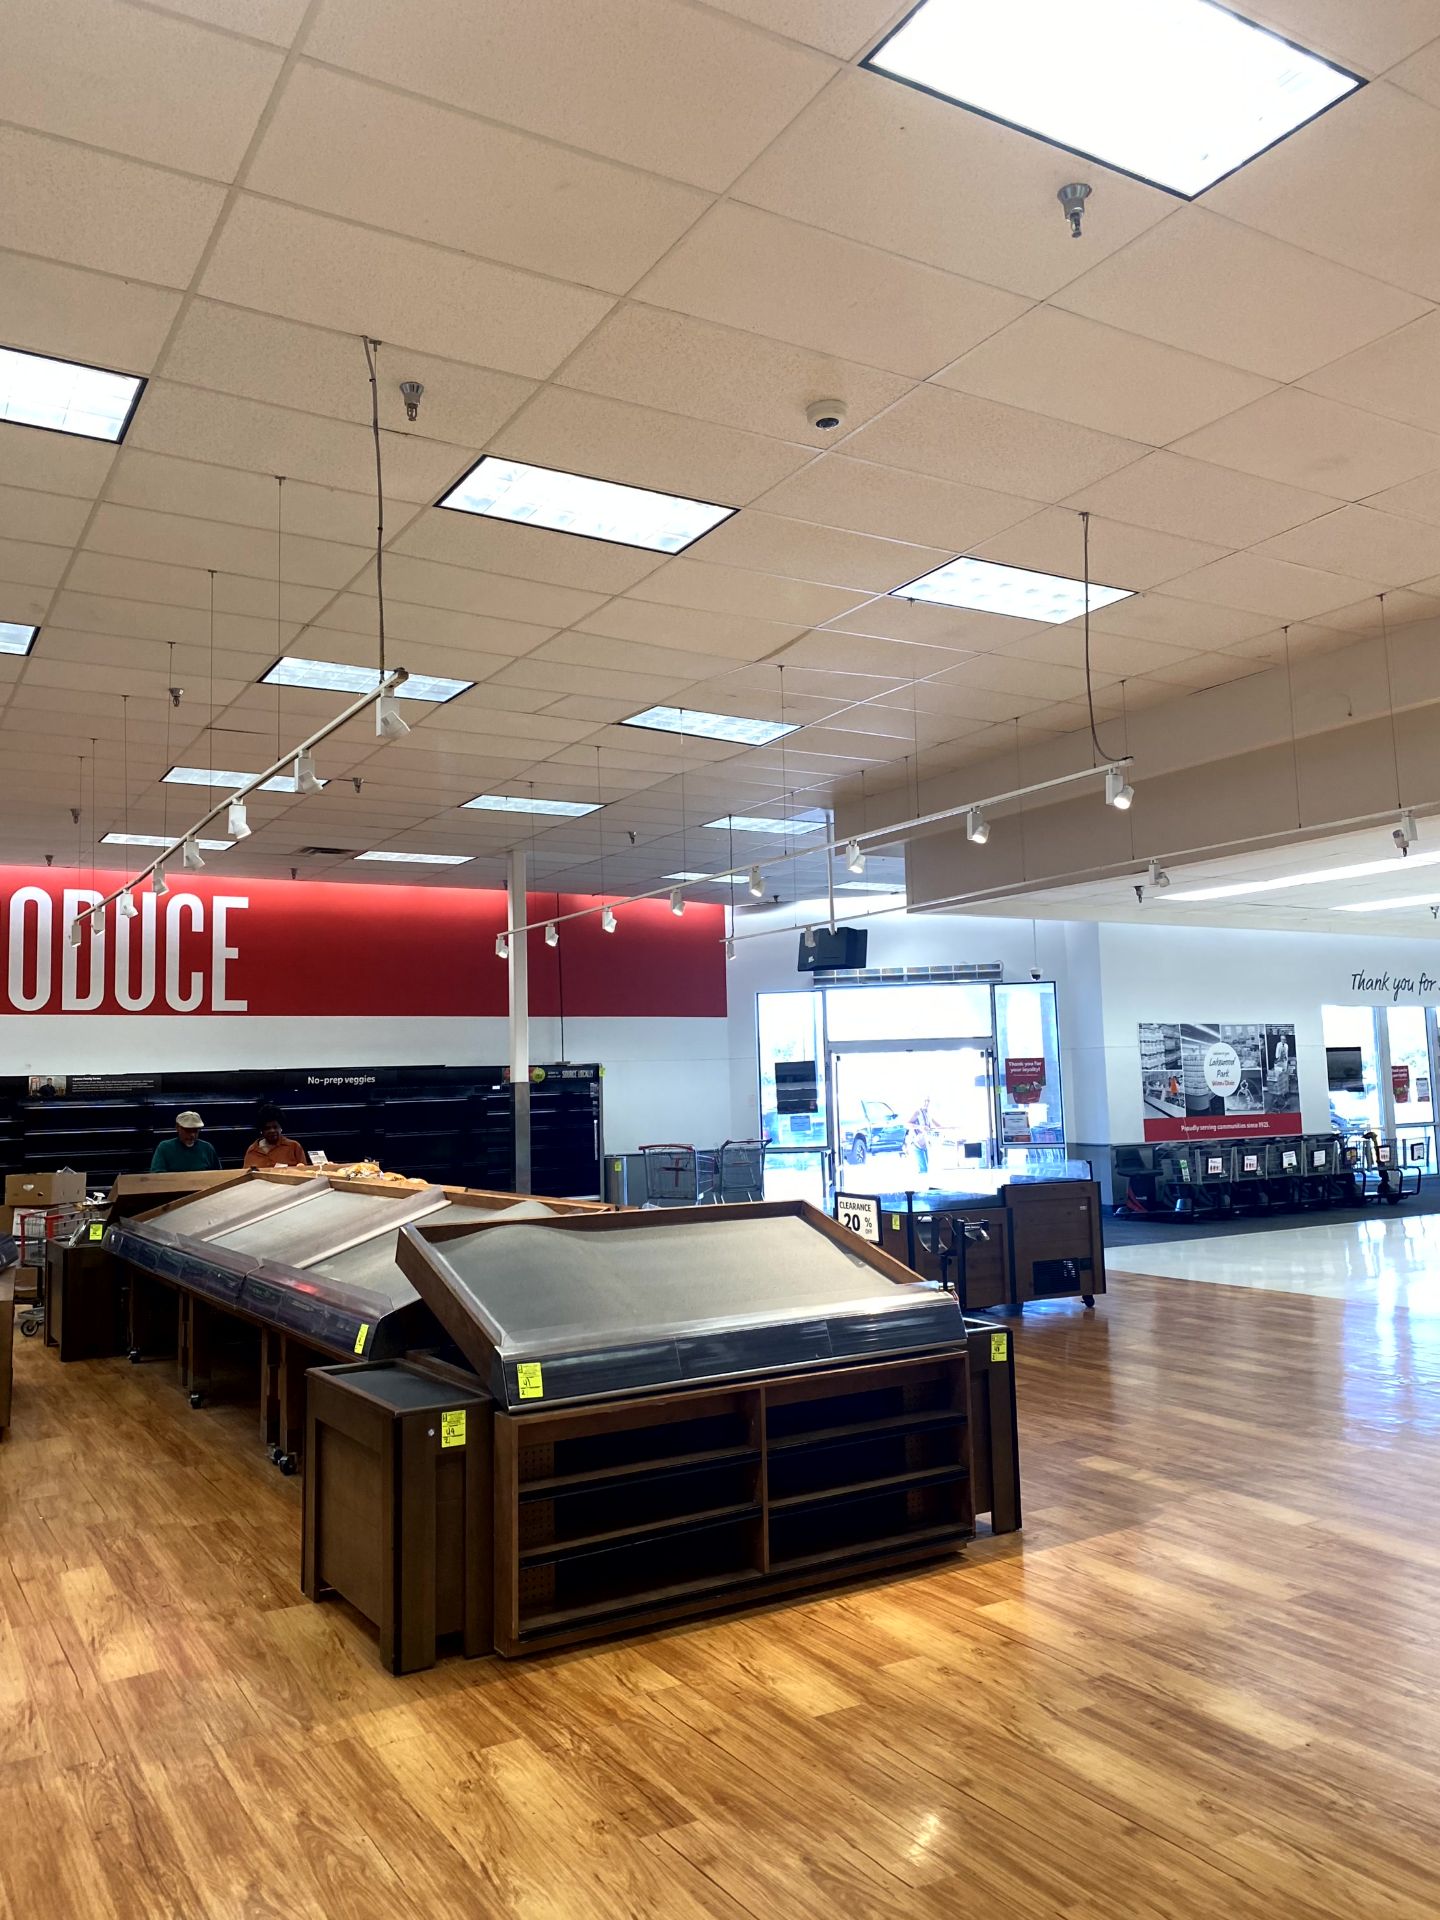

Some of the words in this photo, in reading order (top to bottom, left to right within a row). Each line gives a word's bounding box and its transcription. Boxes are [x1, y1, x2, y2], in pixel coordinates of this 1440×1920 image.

[1352, 969, 1390, 991] Thank
[1393, 977, 1414, 1001] you
[1419, 972, 1437, 996] for
[1216, 1069, 1230, 1078] Park
[307, 1076, 344, 1086] No-prep
[344, 1074, 376, 1086] veggies
[839, 1201, 872, 1213] CLEARANCE
[843, 1213, 860, 1231] 20
